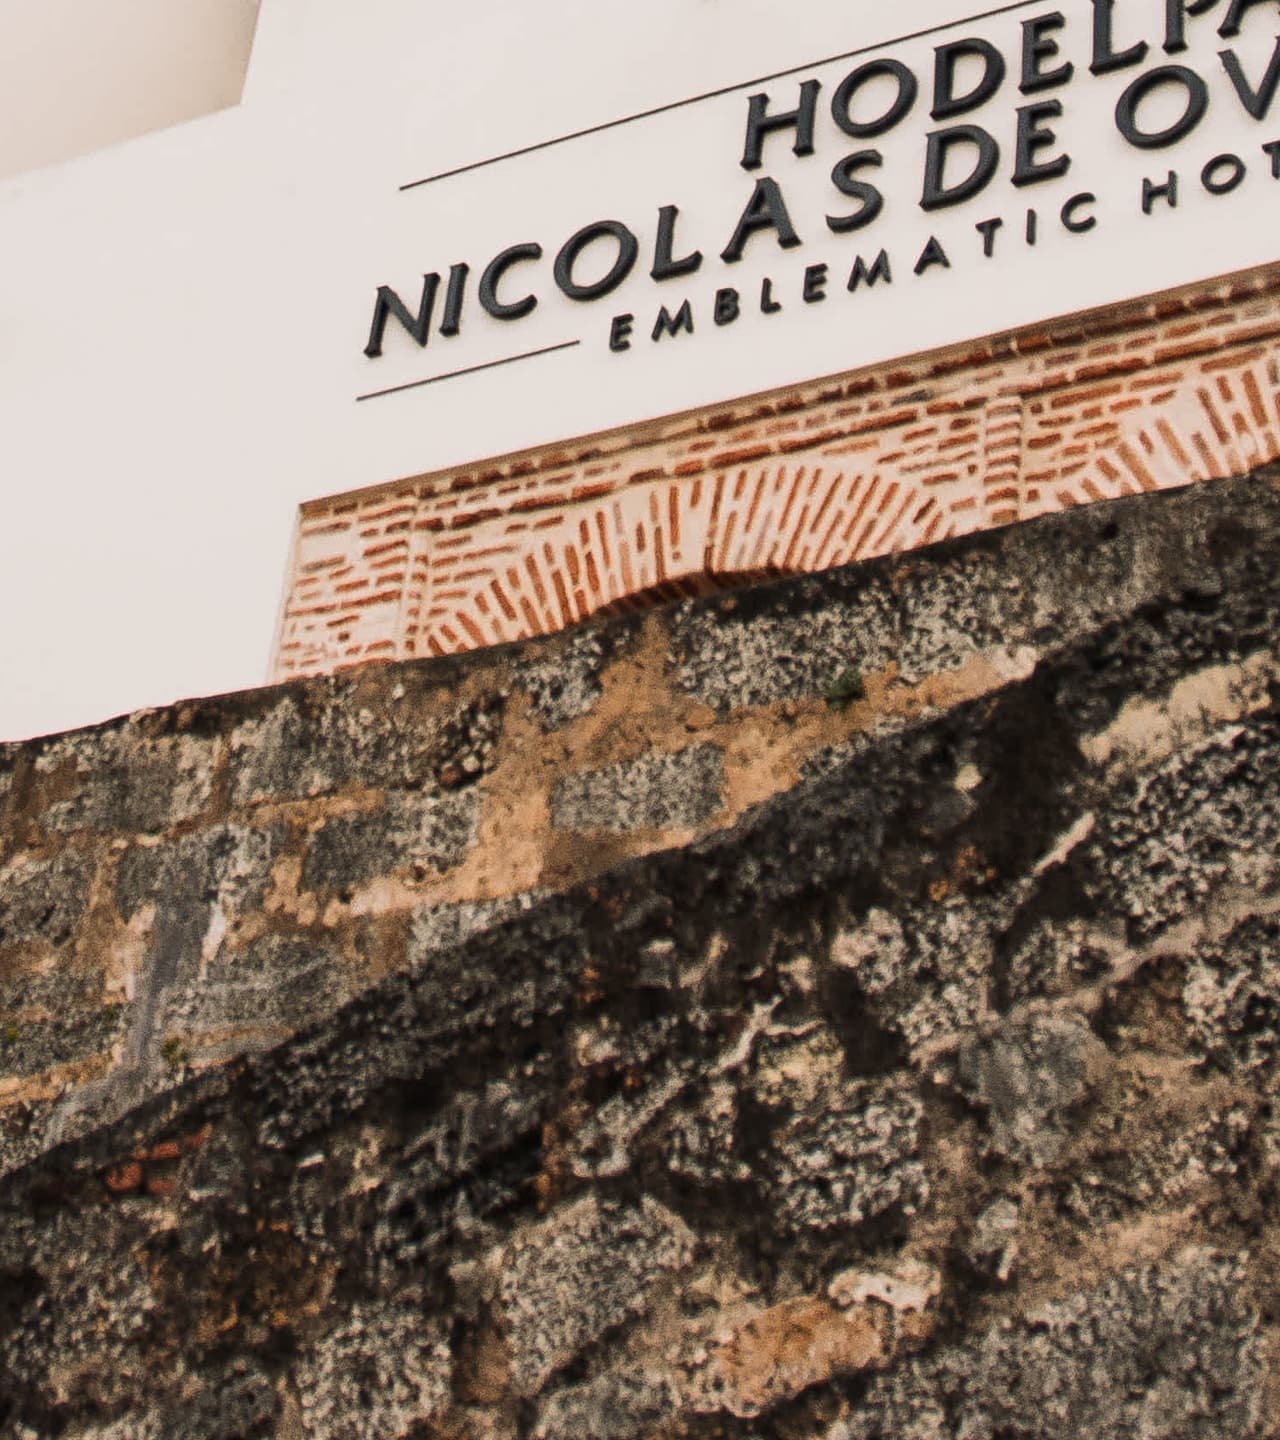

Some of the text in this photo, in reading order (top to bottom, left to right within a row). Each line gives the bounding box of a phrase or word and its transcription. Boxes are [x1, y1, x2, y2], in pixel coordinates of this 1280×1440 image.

[363, 148, 884, 359] NICOLAS
[918, 98, 1072, 213] DE
[608, 192, 1097, 353] EMBLEMATIC
